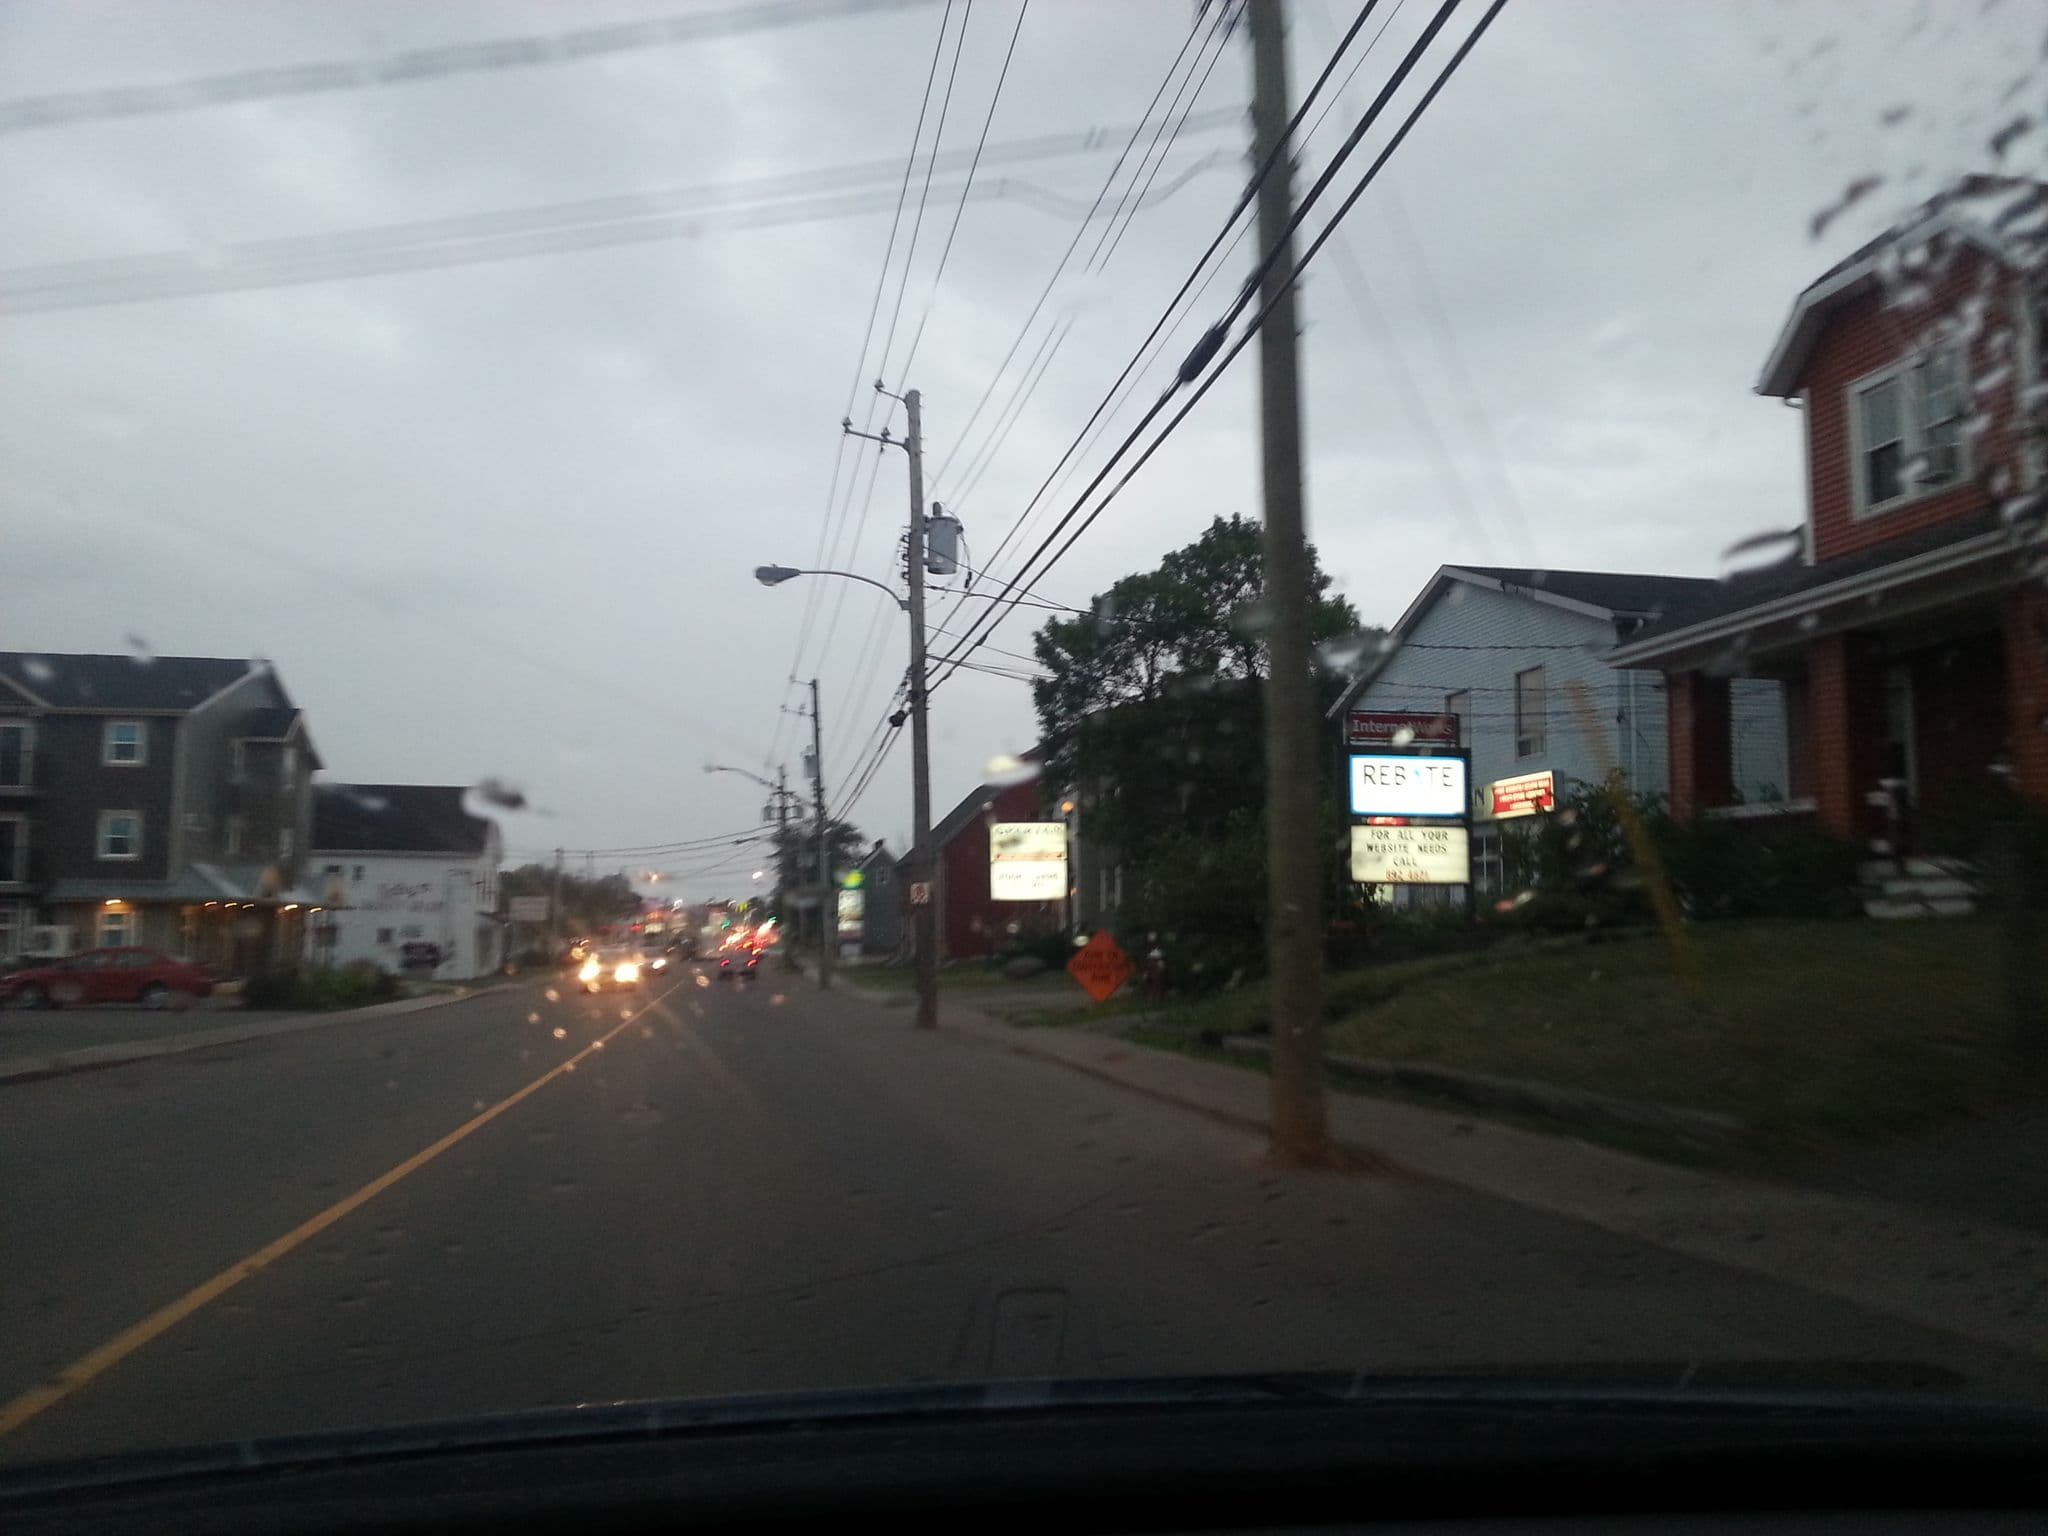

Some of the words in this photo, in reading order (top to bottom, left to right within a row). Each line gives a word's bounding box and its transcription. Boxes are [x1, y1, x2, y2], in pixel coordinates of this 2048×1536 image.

[1364, 765, 1454, 787] REBTE
[1371, 830, 1389, 840] FOR
[1398, 830, 1414, 840] ALL
[1421, 830, 1448, 841] YOUR
[1367, 843, 1408, 854] WEBSITE
[1417, 843, 1447, 854] NEEDS
[1393, 856, 1417, 866] CALL
